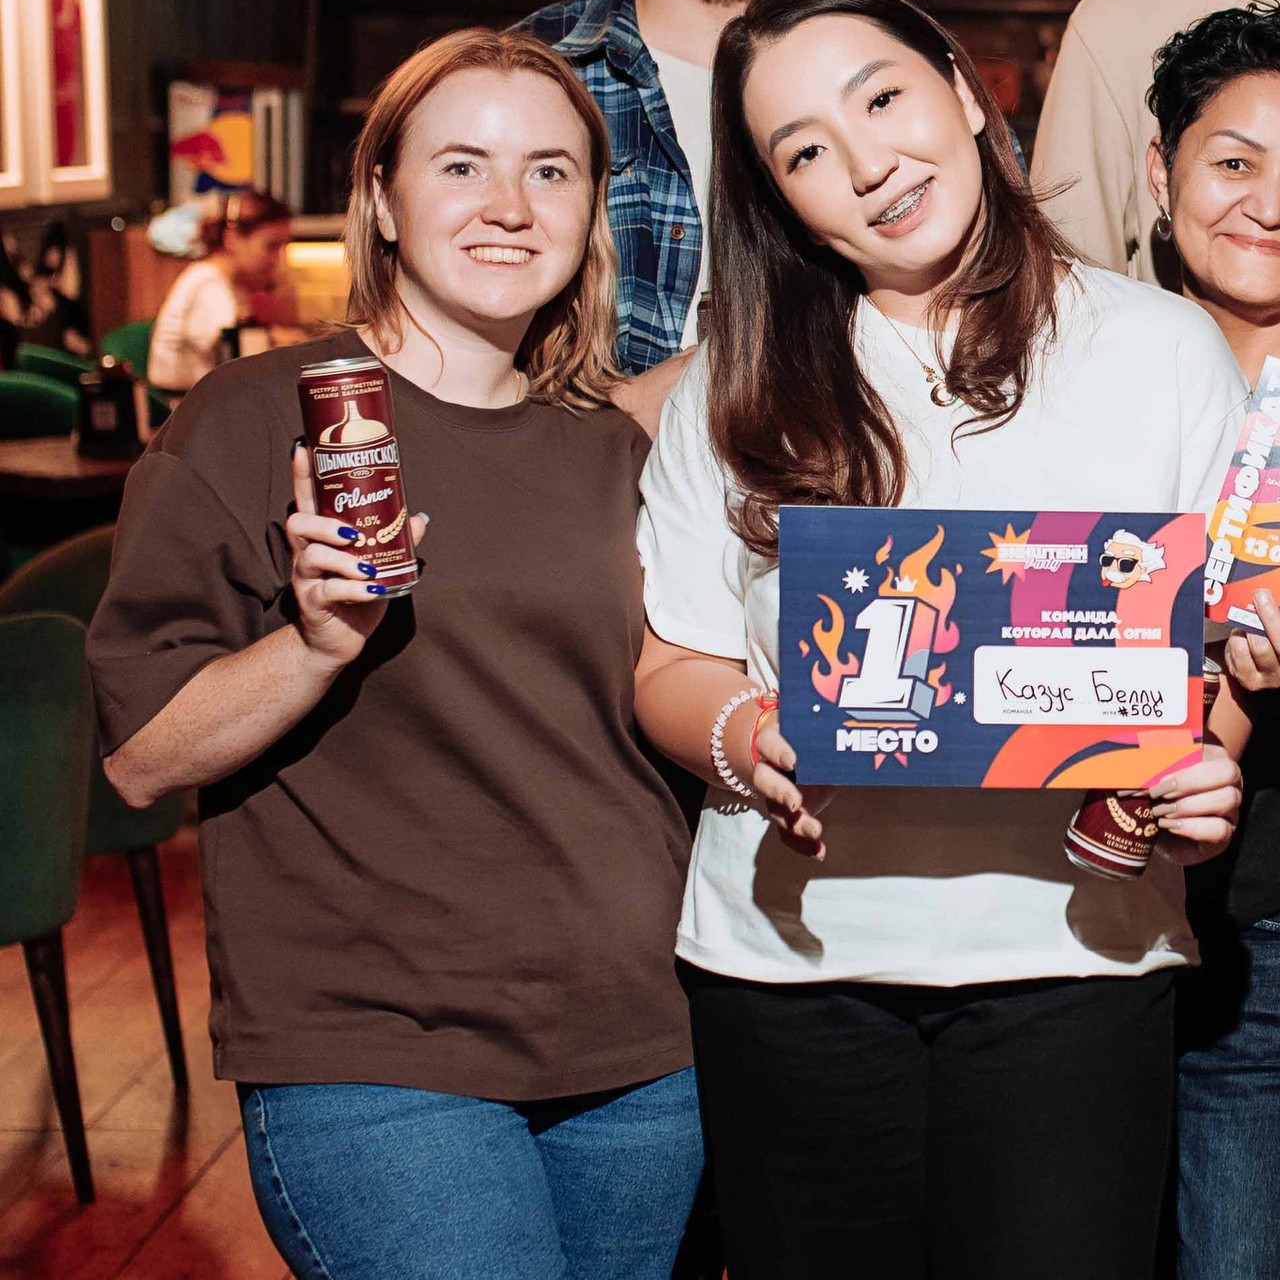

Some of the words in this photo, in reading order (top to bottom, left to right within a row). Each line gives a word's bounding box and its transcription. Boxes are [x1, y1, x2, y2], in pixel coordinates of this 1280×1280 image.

[316, 443, 398, 474] ШЫМКЕНТСКОЕ
[334, 487, 393, 513] Pilsner
[1024, 557, 1061, 572] Party
[1001, 626, 1072, 639] КОТОРАЯ
[1074, 626, 1120, 641] ДАЛА
[1123, 626, 1162, 640] ОГНЯ
[838, 598, 928, 712] 1
[995, 668, 1074, 713] Казус
[836, 729, 939, 754] МЕСТО
